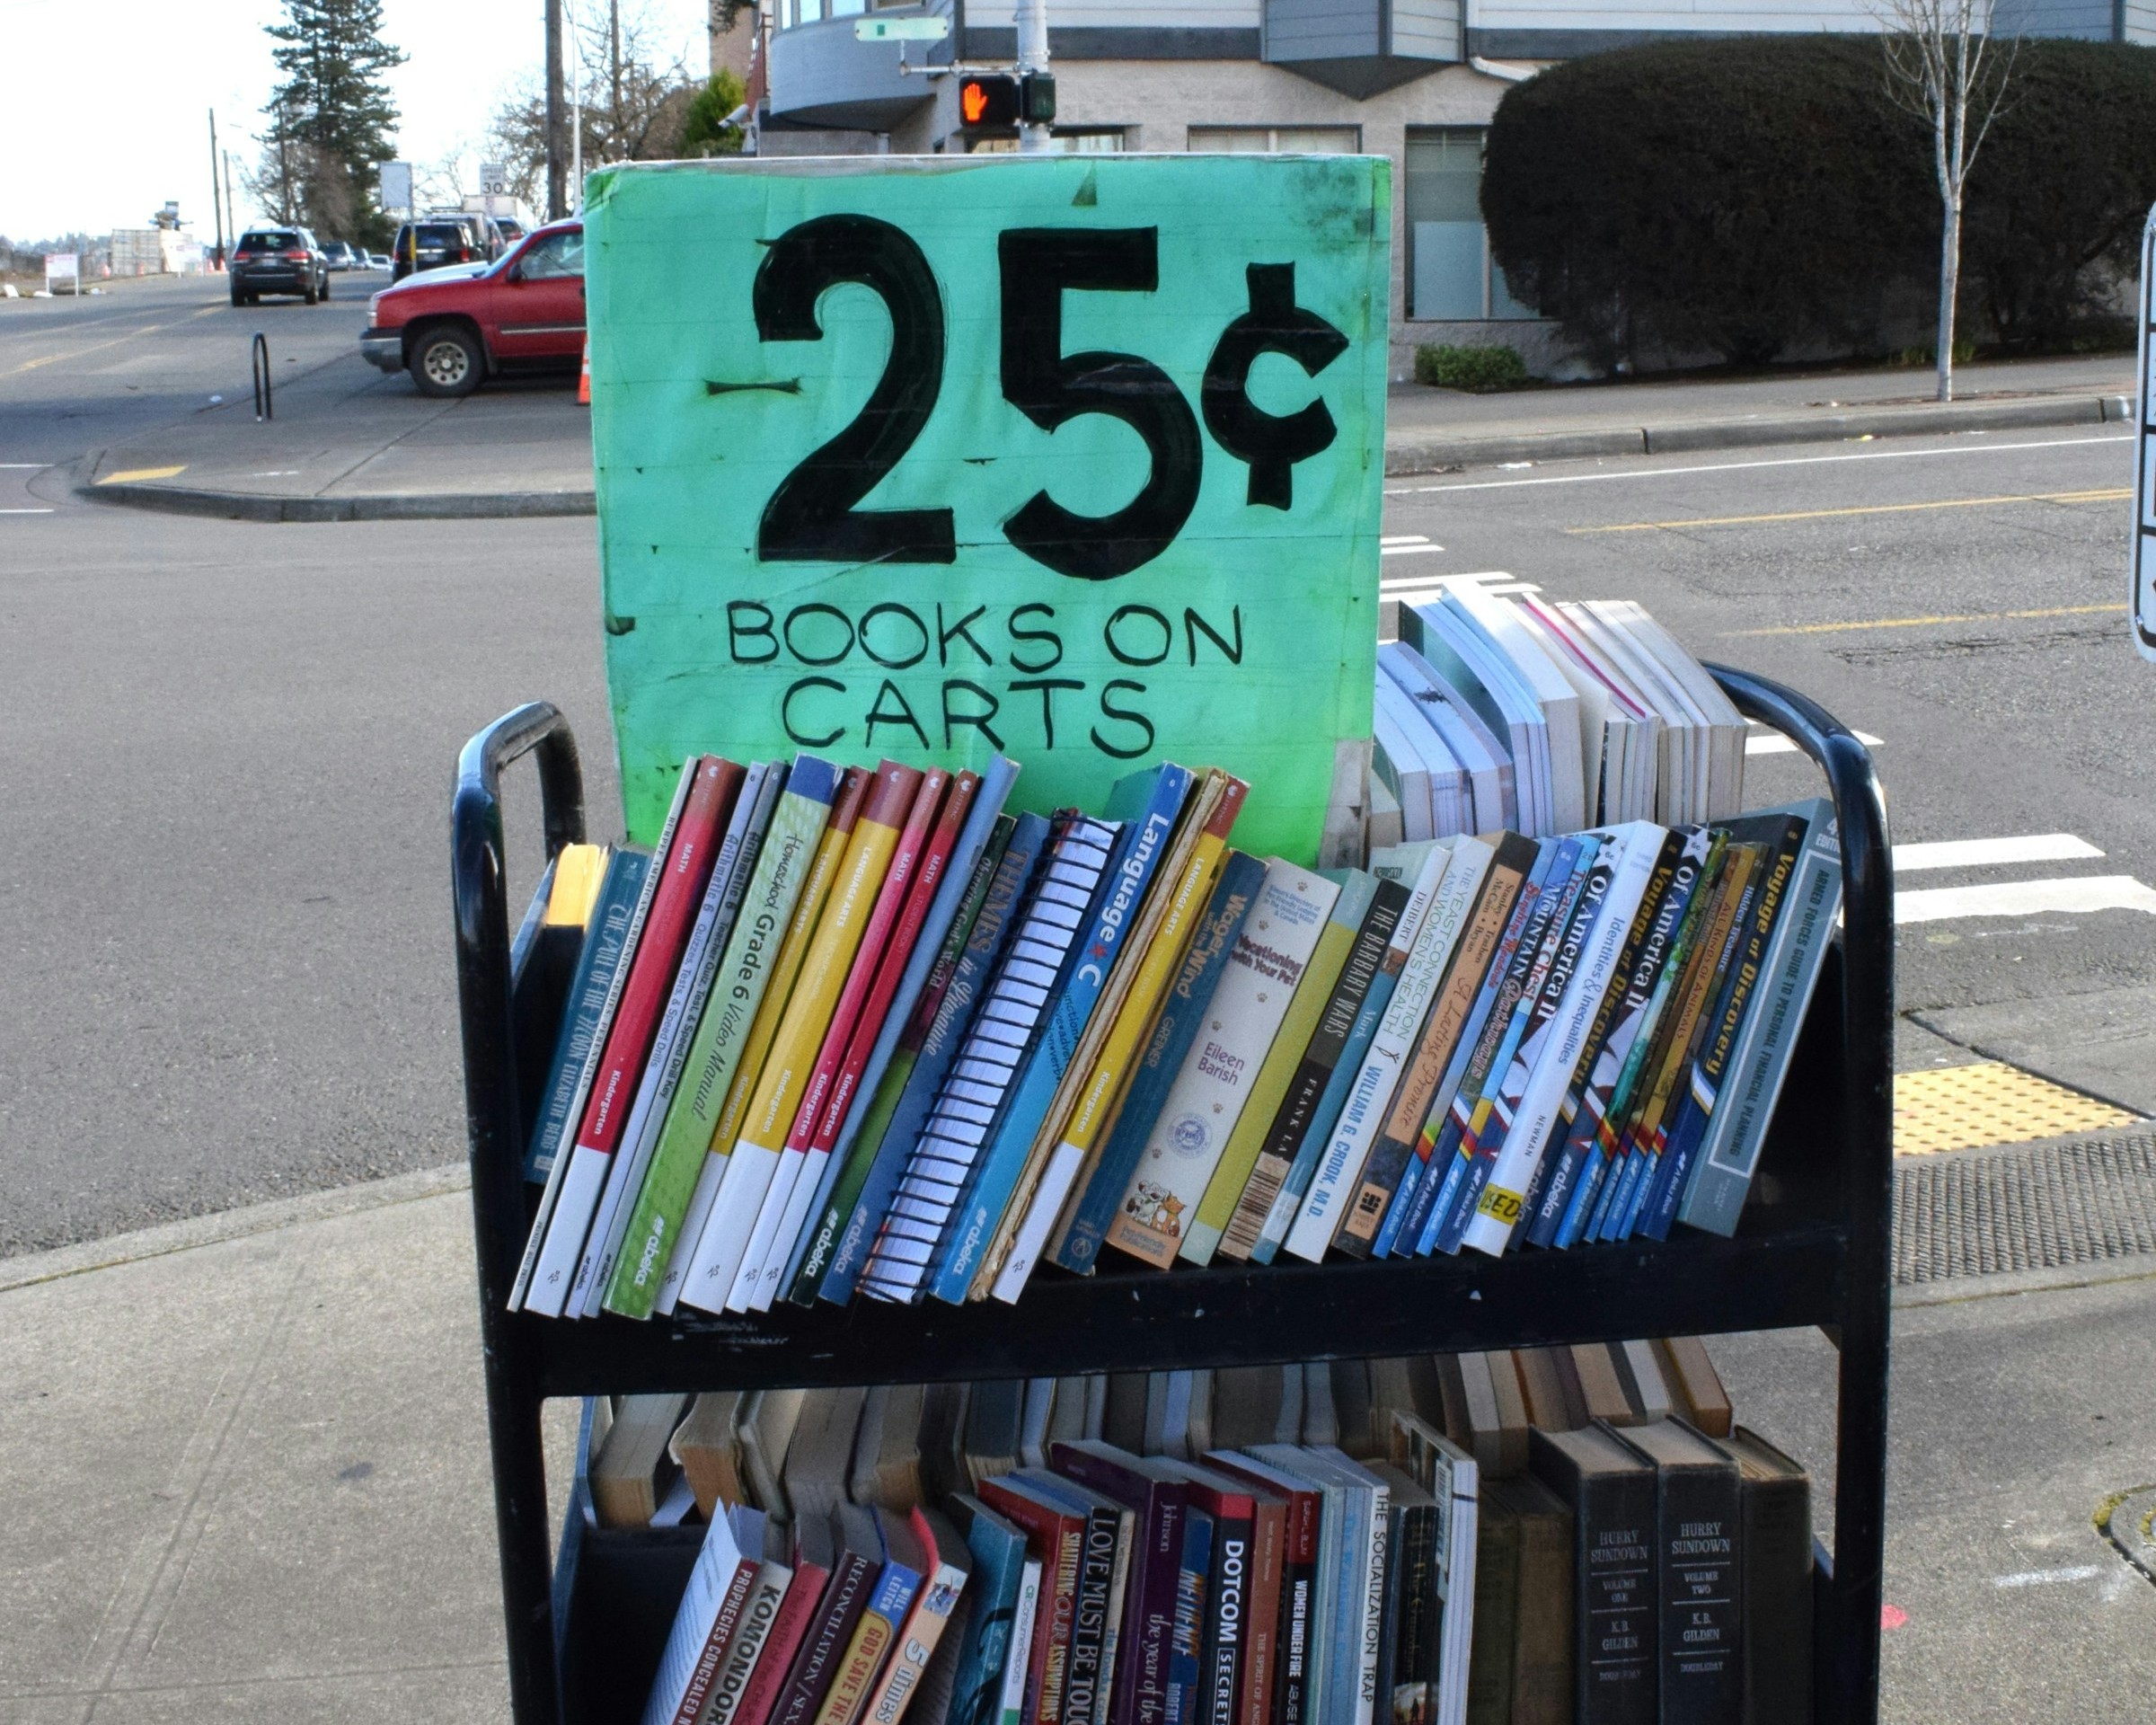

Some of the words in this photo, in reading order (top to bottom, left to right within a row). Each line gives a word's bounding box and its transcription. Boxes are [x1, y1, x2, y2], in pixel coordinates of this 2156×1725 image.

[483, 182, 503, 194] 30
[753, 213, 1349, 582] 25¢
[726, 601, 1063, 674] BOOKS
[1104, 603, 1244, 668] ON
[782, 676, 1157, 759] CARTS
[676, 842, 693, 873] MATH
[706, 833, 737, 900] Arithmetic
[728, 830, 759, 900] Arithmetic
[762, 831, 804, 912] Homeschool
[803, 852, 828, 907] LANGUAGE
[844, 845, 870, 900] LANGUAGE
[894, 852, 911, 882] MATH
[923, 854, 940, 884] MATH
[1094, 809, 1167, 945] Language
[1459, 864, 1475, 889] THE
[1672, 863, 1694, 895] Of
[959, 854, 991, 912] Observing
[968, 844, 1026, 955] THEMES
[1175, 856, 1204, 910] LANGUAGE
[1439, 870, 1457, 898] AND
[1481, 878, 1503, 916] McCain
[1491, 881, 1514, 918] Stanley
[1543, 864, 1586, 947] Treasure
[1583, 872, 1607, 907] Of
[1628, 862, 1671, 948] Voyage
[1735, 884, 1754, 924] Hidden
[1754, 851, 1792, 937] Voyage
[1808, 869, 1829, 906] ARMED
[794, 907, 808, 934] ARTS
[835, 899, 852, 928] ARTS
[945, 911, 968, 949] God's
[1163, 909, 1180, 936] ARTS
[1204, 890, 1246, 959] Wager
[1370, 903, 1397, 933] THE
[1396, 889, 1427, 943] DEIBERT
[1438, 888, 1467, 939] YEAST
[1507, 880, 1541, 939] Sunshine
[1511, 880, 1560, 980] MOUNTAIN
[1717, 901, 1732, 926] ALL
[1796, 906, 1816, 947] FORCES
[683, 921, 705, 967] Quizzes,
[706, 919, 726, 960] Teacher
[737, 911, 776, 984] Grade
[1239, 933, 1303, 977] Vacationing
[1409, 896, 1448, 972] WOMEN'S
[1462, 923, 1483, 955] Bryan
[1548, 903, 1595, 995] America
[1589, 915, 1625, 980] Identities
[1633, 891, 1683, 990] America
[1702, 927, 1723, 965] KINDS
[1718, 924, 1741, 973] Treasure
[1747, 937, 1763, 961] of
[673, 967, 690, 997] Tests,
[928, 947, 953, 988] World
[957, 956, 976, 976] in
[1075, 960, 1103, 987] C
[1174, 946, 1209, 1000] Wind
[1342, 931, 1384, 996] BARBARY
[1485, 934, 1517, 990] Meadows
[1520, 945, 1554, 1003] Chest
[1785, 947, 1804, 980] GUIDE
[669, 996, 681, 1008] &
[731, 983, 750, 1002] 6
[1383, 972, 1417, 1035] HEALTH
[1397, 938, 1445, 1040] CONNECTION
[1581, 977, 1604, 995] &
[1780, 981, 1794, 996] TO
[658, 1007, 677, 1041] Speed
[685, 1013, 695, 1023] &
[713, 1001, 744, 1049] Video
[922, 974, 972, 1059] Literature
[1323, 995, 1356, 1039] WARS
[1354, 1006, 1376, 1041] Mark
[1419, 996, 1464, 1063] Lasting
[1467, 975, 1524, 1084] Pathways
[1557, 992, 1595, 1067] Inequalities
[1570, 970, 1626, 1088] Discovery
[1674, 981, 1703, 1042] ANIMALS
[1704, 960, 1755, 1077] Discovery
[1763, 996, 1789, 1049] PERSONAL
[649, 1040, 667, 1069] Drills
[674, 1022, 692, 1057] Speed
[1144, 1014, 1174, 1068] GREINER
[1203, 1040, 1245, 1072] Eileen
[658, 1077, 673, 1099] Key
[667, 1056, 681, 1079] Drill
[688, 1048, 727, 1120] Manual
[1197, 1056, 1239, 1086] Barish
[1745, 1049, 1772, 1103] FINANCIAL
[592, 1069, 622, 1136] Kindergarten
[719, 1074, 749, 1140] Kindergarten
[762, 1068, 792, 1134] Kindergarten
[795, 1071, 828, 1137] Kindergarten
[821, 1072, 853, 1137] Kindergarten
[1075, 1069, 1110, 1135] Kindergarten
[1288, 1077, 1317, 1128] FRANK
[1347, 1064, 1383, 1124] WILLIAM
[1397, 1061, 1438, 1131] Promise
[1524, 1113, 1545, 1158] NEWMAN
[1728, 1104, 1754, 1157] PLANNING
[1317, 1137, 1351, 1189] CROOK,
[1306, 1188, 1330, 1221] M.D.
[1540, 1170, 1568, 1219] abeka
[1452, 1209, 1466, 1230] Book
[632, 1233, 662, 1287] abeka
[804, 1225, 835, 1278] abeka
[834, 1223, 865, 1276] abeka
[950, 1224, 983, 1277] abeka
[1155, 1502, 1175, 1552] Johnson
[1374, 1492, 1387, 1520] THE
[1086, 1517, 1117, 1575] LOVE
[1600, 1530, 1639, 1545] HURRY
[1672, 1539, 1730, 1554] SUNDOWN
[1681, 1522, 1721, 1537] HURRY
[1056, 1529, 1080, 1598] SHATTERING
[1591, 1546, 1648, 1563] SUNDOWN
[1684, 1571, 1719, 1583] VOLUME
[712, 1568, 753, 1643] PROPHECIES
[878, 1574, 902, 1612] LEITCH
[891, 1585, 911, 1611] WILL
[1078, 1580, 1108, 1639] MUST
[1218, 1538, 1243, 1644] DOTCOM
[1291, 1579, 1307, 1618] WOMEN
[1364, 1530, 1385, 1654] SOCIALIZATION
[1692, 1585, 1711, 1595] TWO
[802, 1556, 869, 1684] RECONCILIATION
[858, 1626, 883, 1657] GOD
[1148, 1613, 1171, 1640] the
[1257, 1632, 1266, 1651] THE
[1289, 1619, 1303, 1654] UNDER
[1602, 1635, 1638, 1650] GILDEN
[1683, 1628, 1719, 1642] GILDEN
[705, 1583, 781, 1725] KOMONDOR
[900, 1636, 933, 1668] 5
[1074, 1643, 1100, 1671] BE
[1139, 1639, 1159, 1678] year
[1253, 1653, 1264, 1684] SPIRIT
[1287, 1655, 1302, 1677] FIRE
[682, 1643, 721, 1715] CONCEALED
[842, 1657, 869, 1694] SAVE
[874, 1663, 917, 1725] dimes
[1039, 1642, 1065, 1723] ASSUMPTIONS
[1252, 1686, 1261, 1701] OF
[1360, 1666, 1374, 1702] TRAP
[827, 1694, 851, 1722] THE
[1163, 1682, 1180, 1722] ROBERT
[1286, 1684, 1297, 1721] ABUSE
